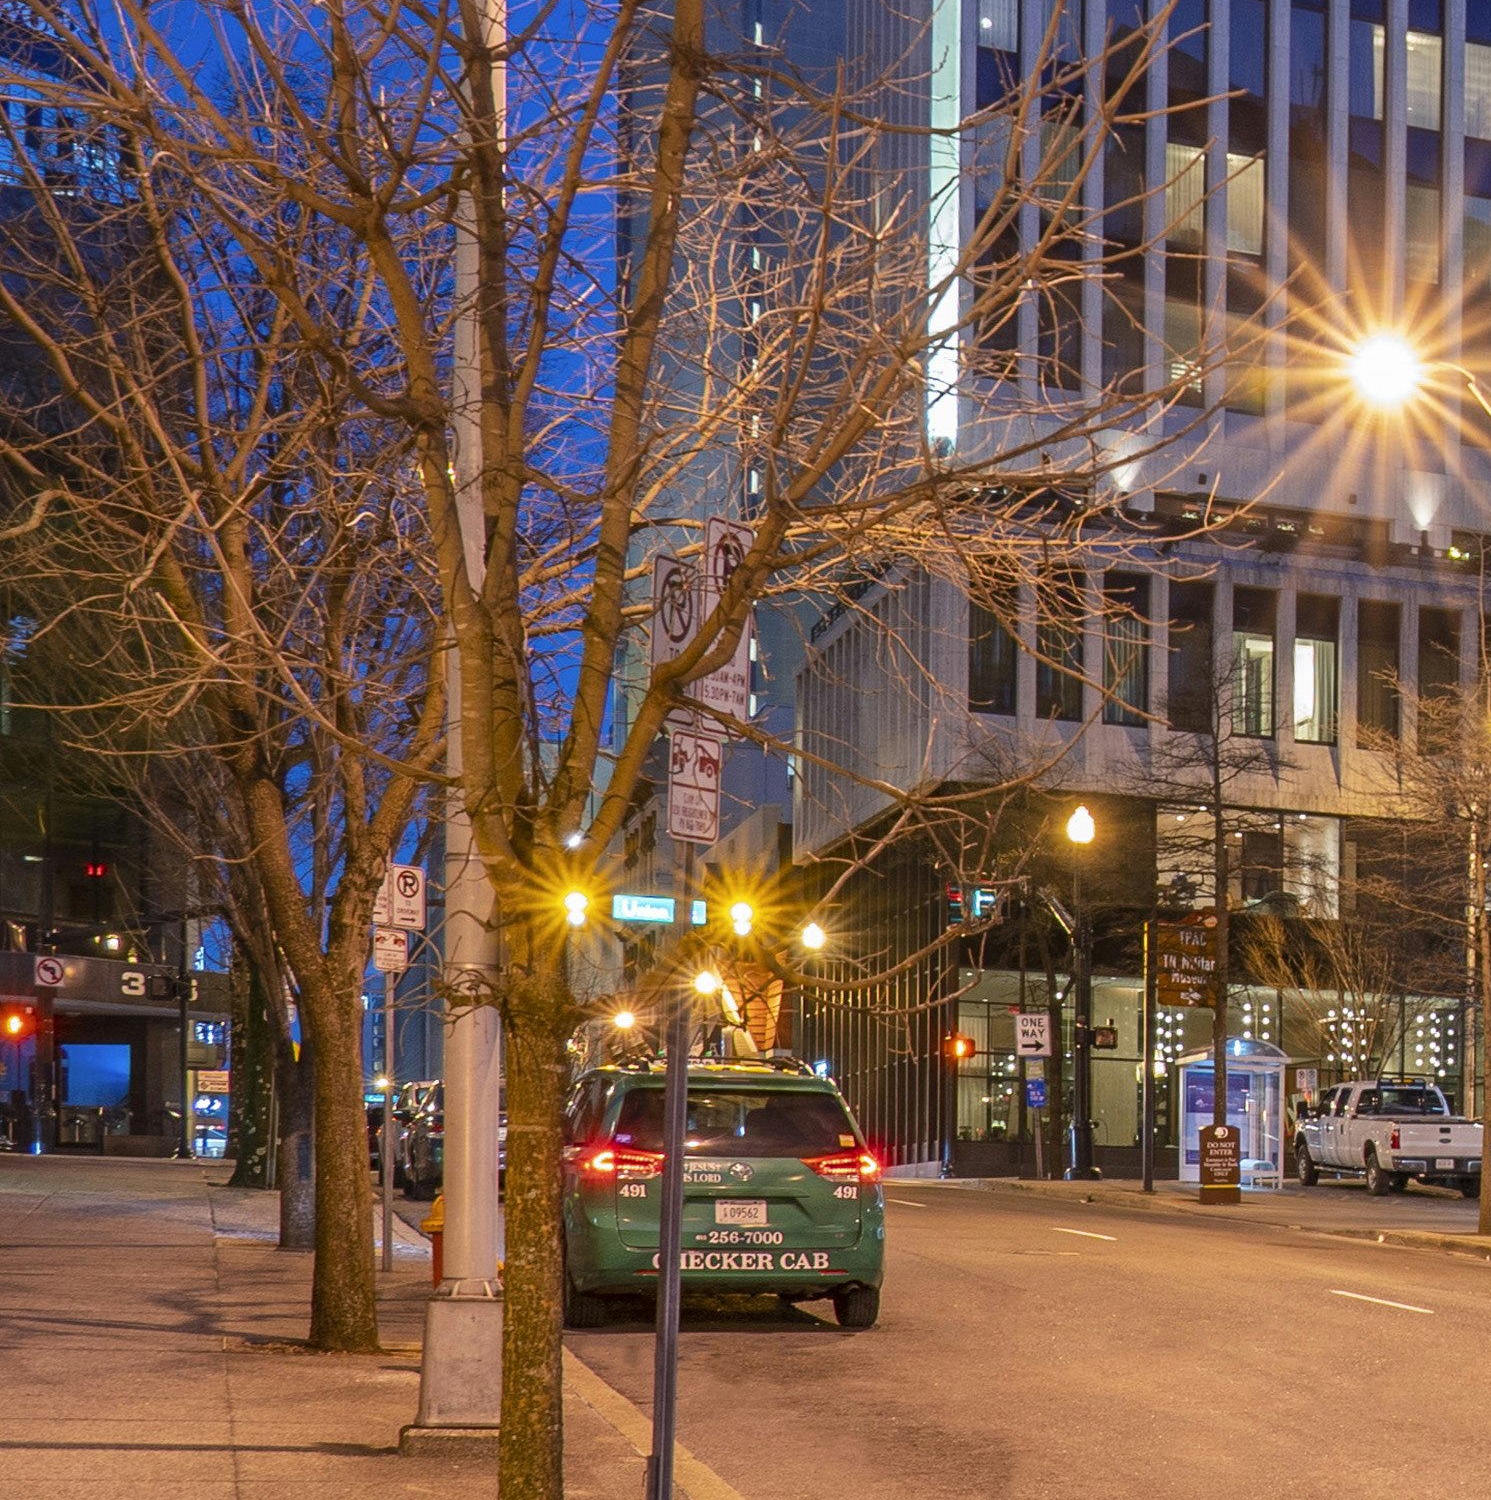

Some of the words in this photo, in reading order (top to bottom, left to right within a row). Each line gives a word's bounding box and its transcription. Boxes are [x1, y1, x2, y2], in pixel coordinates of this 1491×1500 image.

[621, 898, 670, 919] Union
[1021, 1018, 1044, 1028] ONE
[1021, 1029, 1045, 1038] WAY
[1207, 1141, 1219, 1149] DO
[1220, 1141, 1236, 1149] NOT
[688, 1162, 717, 1173] JESUS
[683, 1173, 693, 1183] IS
[694, 1173, 722, 1184] LORD
[619, 1184, 647, 1198] 491
[833, 1185, 858, 1199] 491
[729, 1207, 759, 1219] 09562
[708, 1231, 784, 1245] 256-7000
[780, 1252, 830, 1270] CAB
